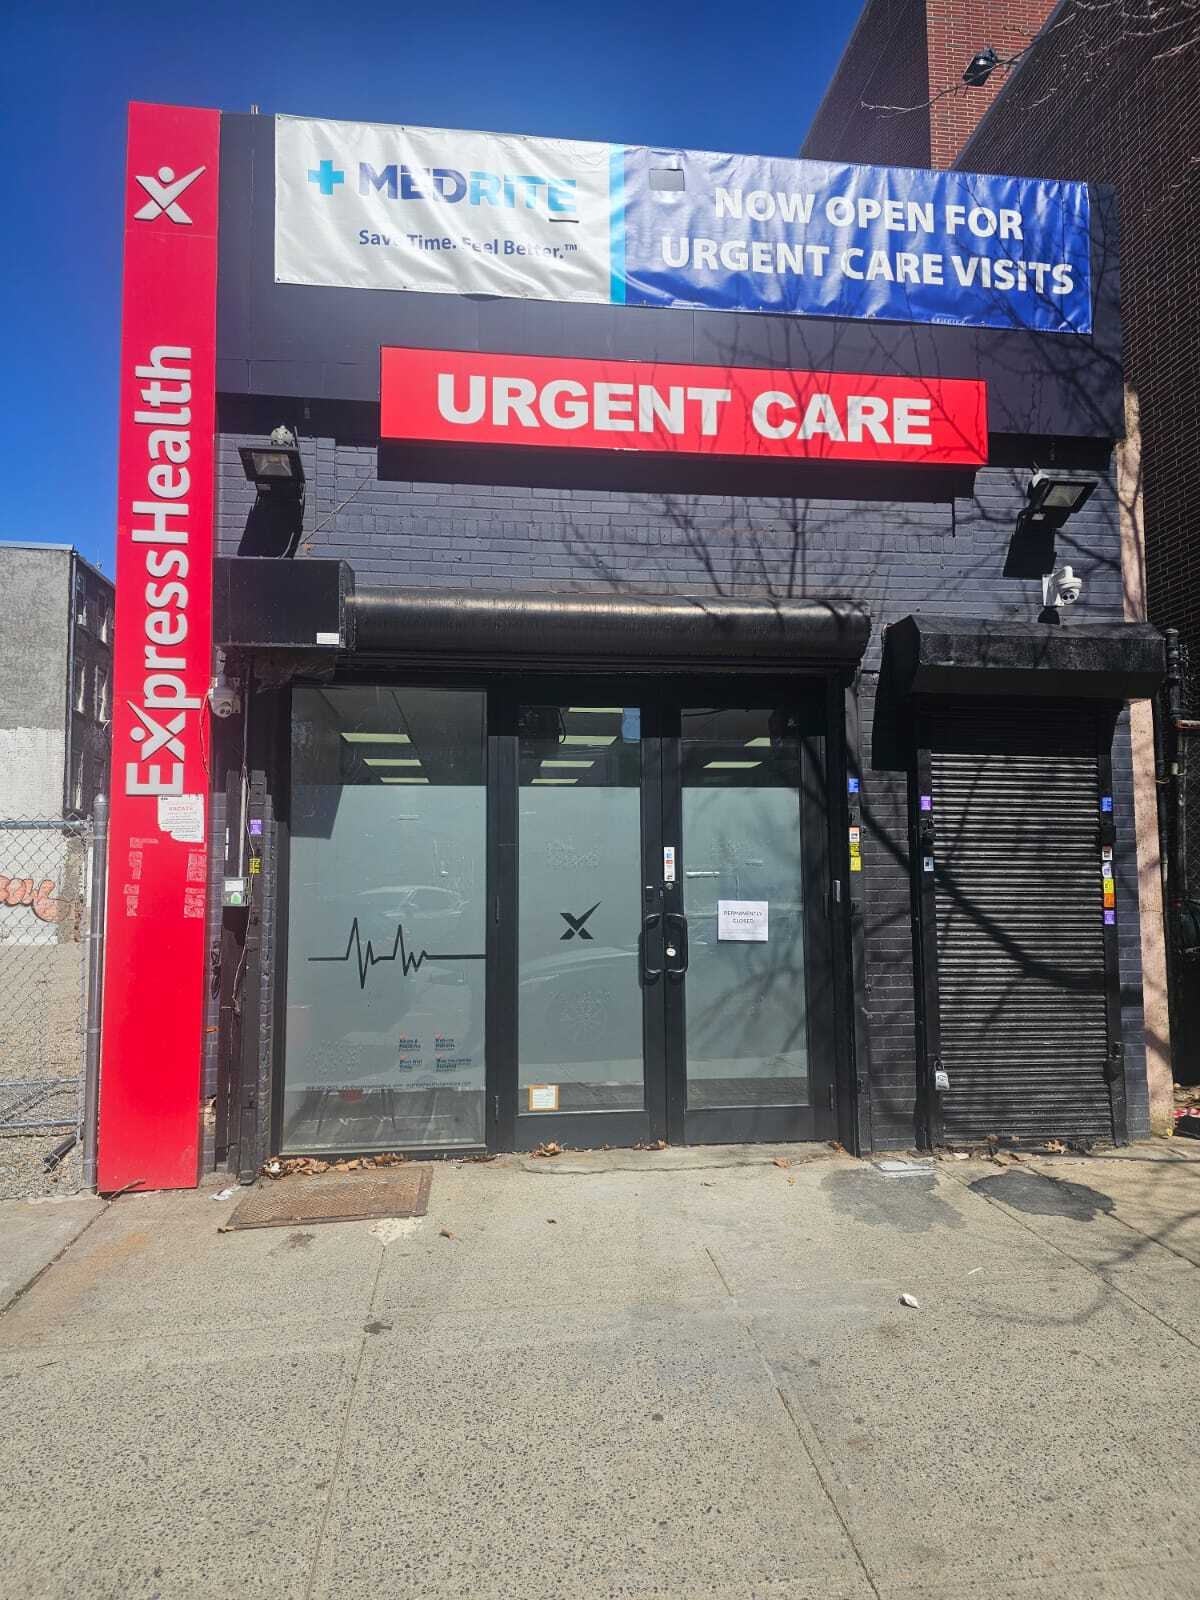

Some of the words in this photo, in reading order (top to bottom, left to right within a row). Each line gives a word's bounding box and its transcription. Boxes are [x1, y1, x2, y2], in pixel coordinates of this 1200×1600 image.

[358, 161, 577, 212] MEDRITE
[714, 187, 815, 225] NOW
[825, 195, 935, 233] OPEN
[945, 205, 1024, 241] FOR
[407, 233, 457, 250] Time.
[661, 236, 830, 278] URGENT
[840, 247, 945, 286] CARE
[950, 254, 1074, 295] VISITS
[436, 373, 732, 437] URGENT
[751, 390, 933, 446] CARE
[125, 345, 201, 797] ExpressHealth
